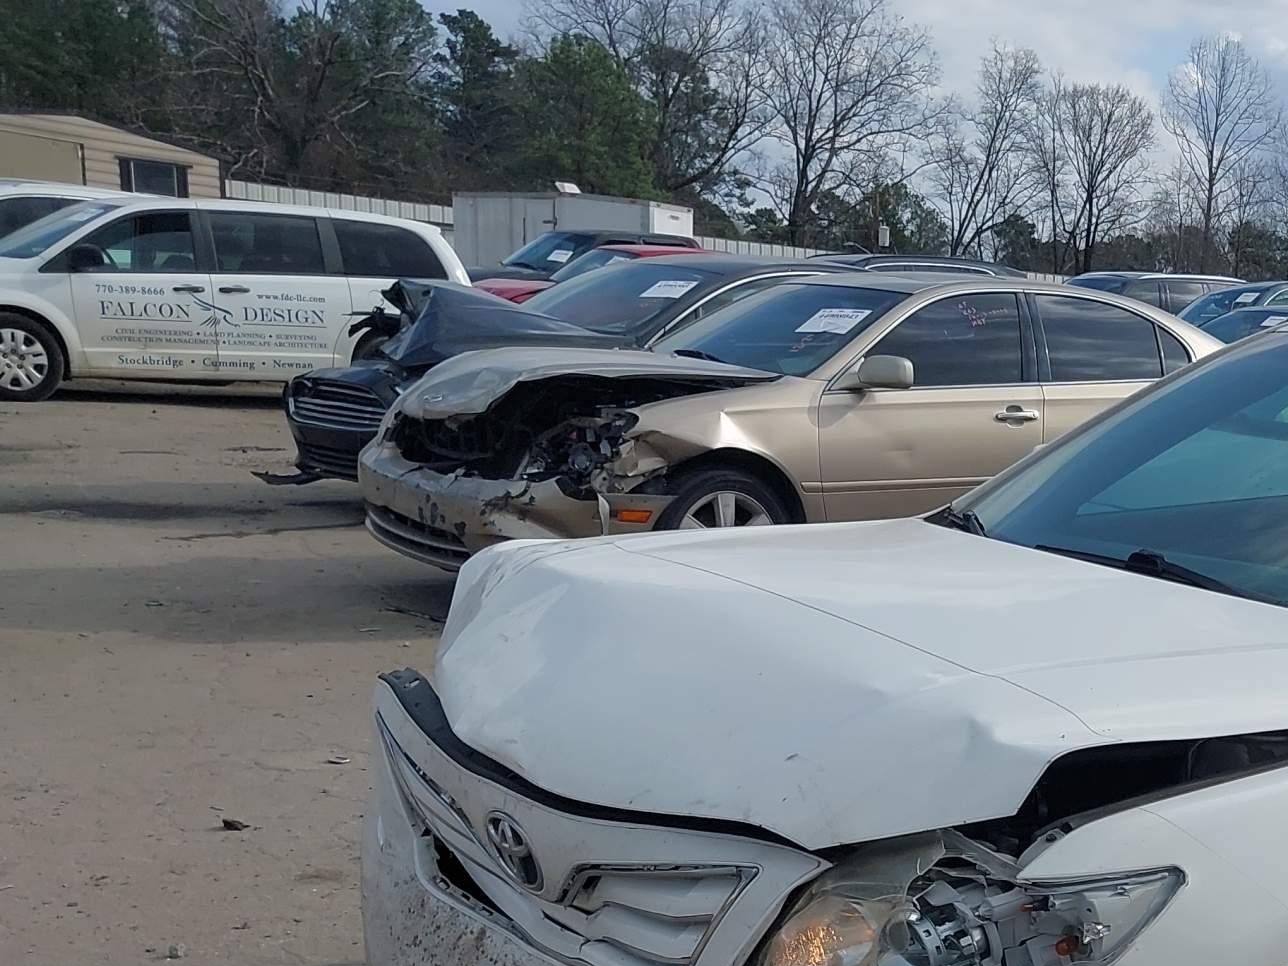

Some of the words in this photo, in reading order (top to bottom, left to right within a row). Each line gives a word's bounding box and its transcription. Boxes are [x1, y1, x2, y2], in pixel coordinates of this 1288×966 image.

[95, 284, 165, 296] 770-389-8666
[256, 292, 326, 303] www.fdc-llc.com
[99, 300, 191, 319] FALCON
[242, 306, 325, 324] DESIGN
[115, 327, 135, 335] CIVIL
[138, 328, 193, 337] ENGINEERING
[227, 332, 266, 340] PLANNING
[100, 335, 163, 343] CONSTRUCTION
[165, 336, 220, 345] MANAGEMENT
[228, 339, 271, 347] LANDSCAPE
[274, 341, 327, 349] ARCHITECTURE
[118, 355, 184, 369] Stockbridge
[202, 357, 256, 371] Cumming
[273, 359, 313, 369] Newnan
